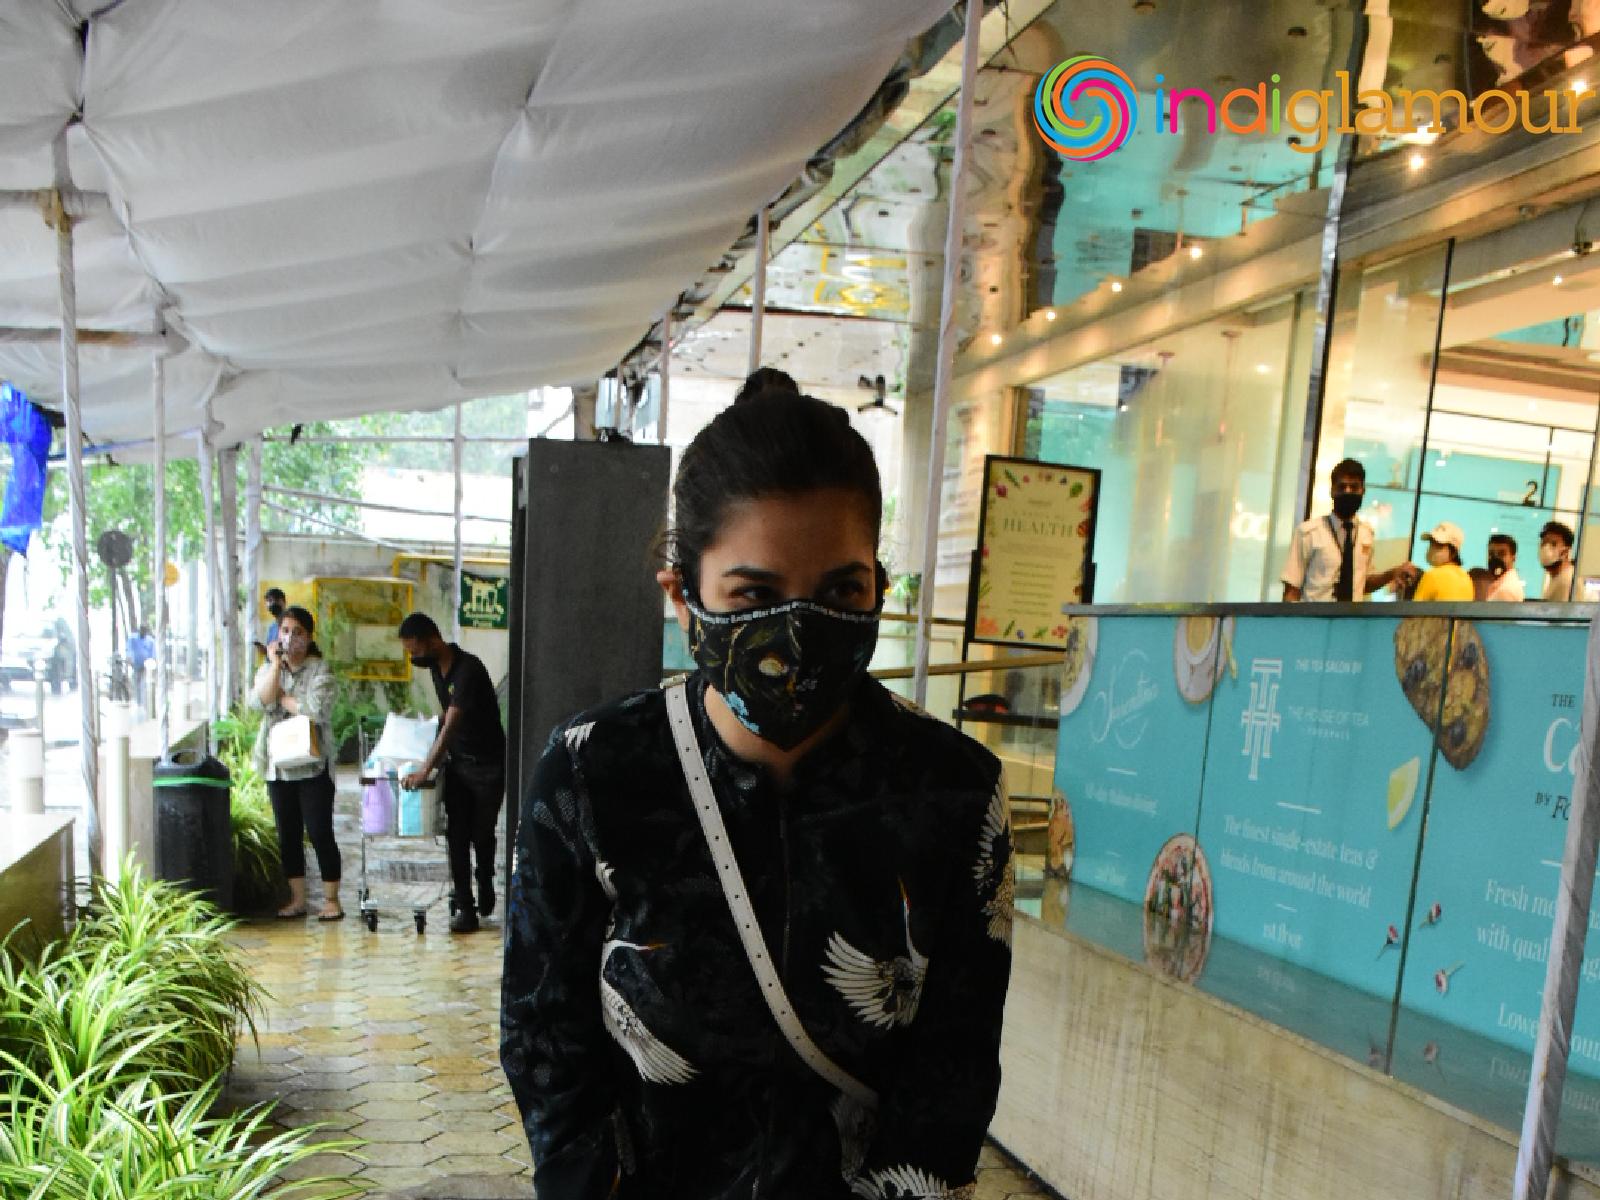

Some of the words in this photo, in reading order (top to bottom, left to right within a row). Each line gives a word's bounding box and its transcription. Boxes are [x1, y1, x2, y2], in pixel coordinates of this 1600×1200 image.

[1552, 693, 1576, 708] THE
[1485, 878, 1528, 912] Fresh
[1476, 922, 1510, 953] with
[1512, 936, 1549, 962] qual
